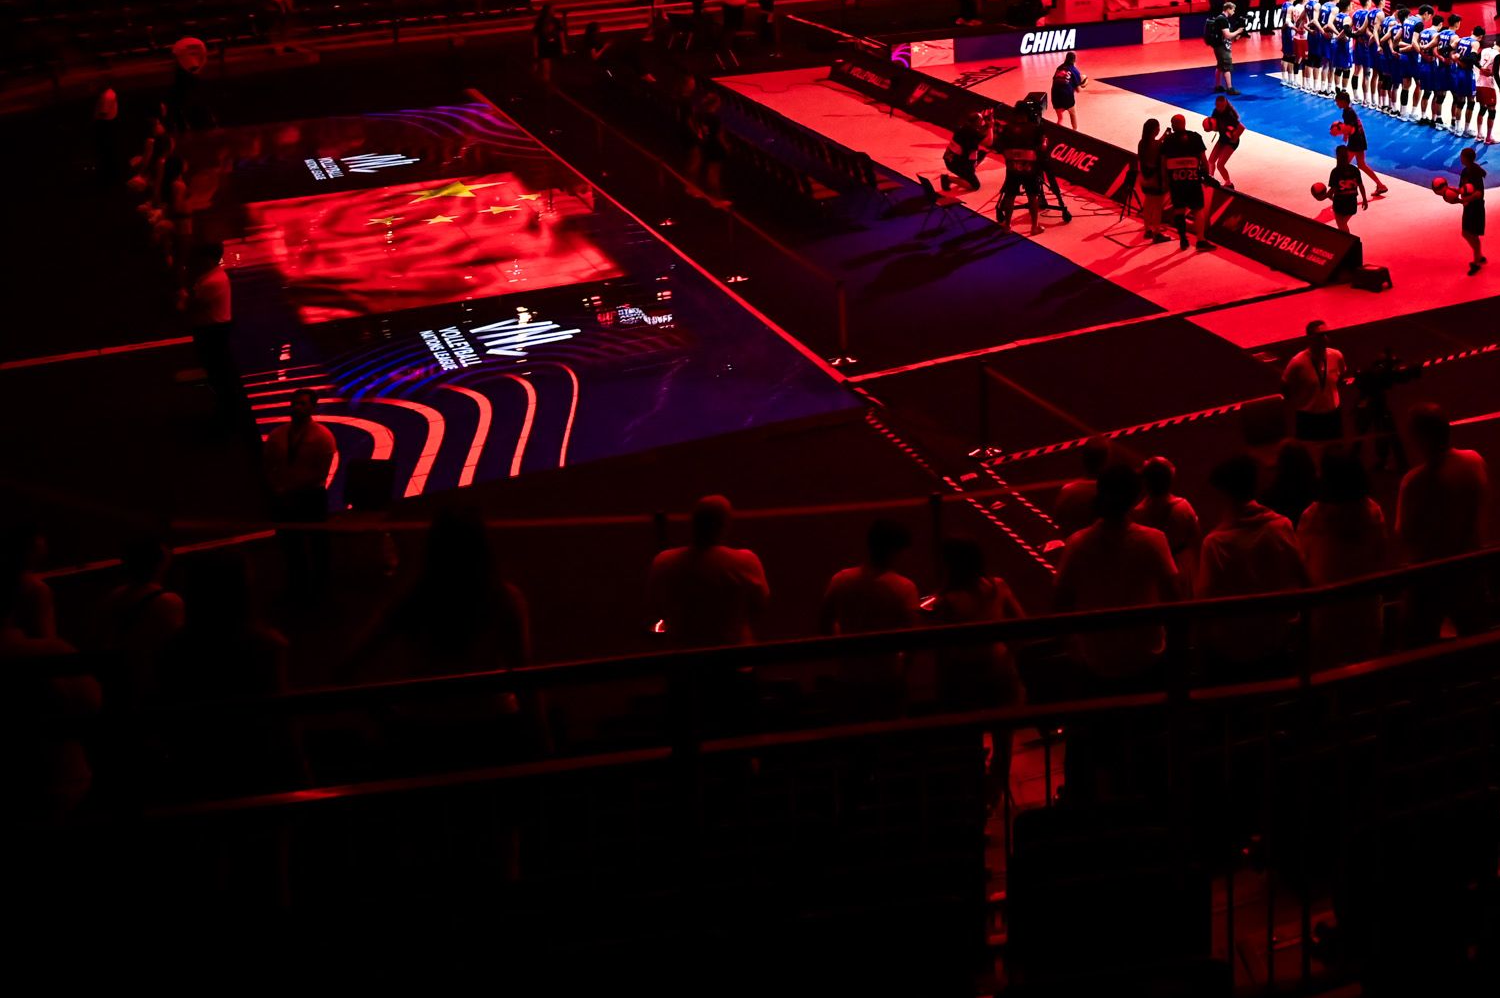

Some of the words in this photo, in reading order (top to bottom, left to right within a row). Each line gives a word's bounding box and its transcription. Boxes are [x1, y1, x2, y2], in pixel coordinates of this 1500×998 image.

[1020, 28, 1077, 55] CHINA
[1051, 143, 1099, 173] GLIWICE
[1241, 221, 1310, 259] VOLLEYBALL
[438, 326, 482, 368] VOLLEYBALL
